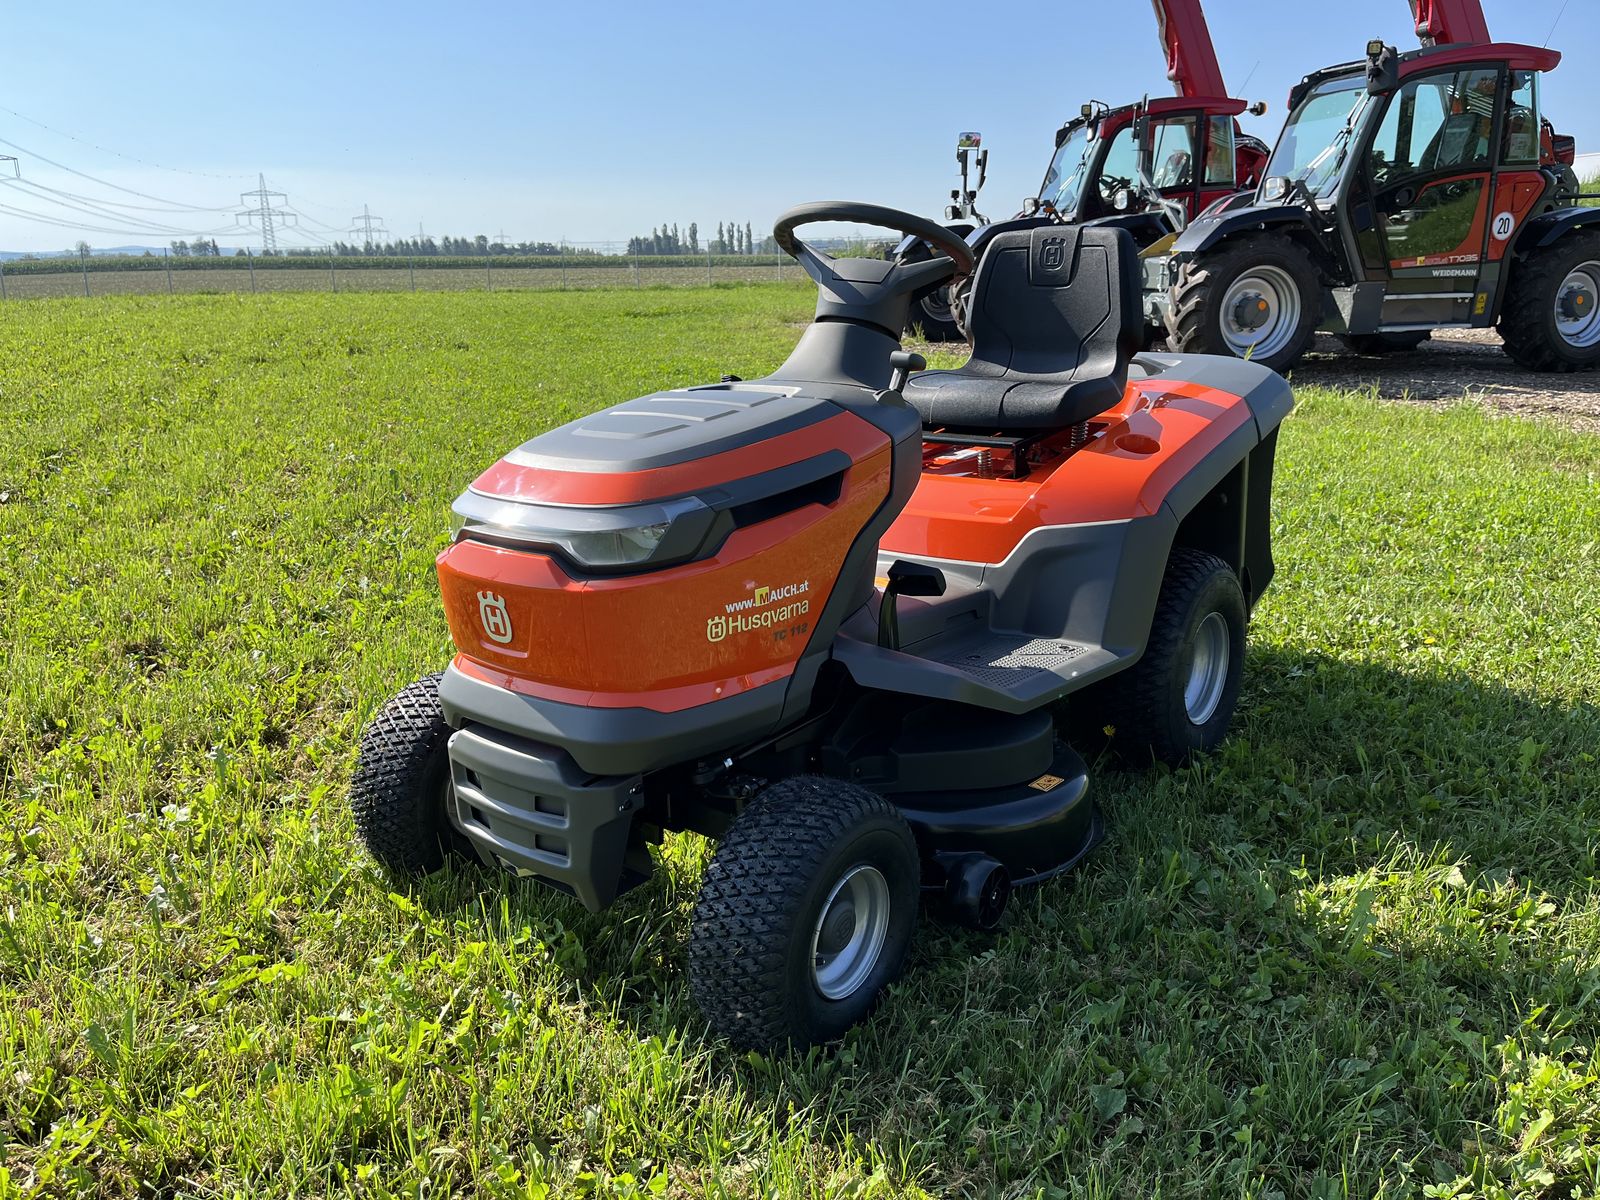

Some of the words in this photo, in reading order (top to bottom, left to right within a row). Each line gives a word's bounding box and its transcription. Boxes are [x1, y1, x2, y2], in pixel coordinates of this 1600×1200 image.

[1497, 217, 1510, 235] 20
[1432, 269, 1477, 277] WEIDEMANN
[725, 580, 809, 614] www.MAUCH.at
[728, 599, 809, 635] Husqvarna
[772, 629, 788, 641] TC
[791, 622, 808, 637] 112
